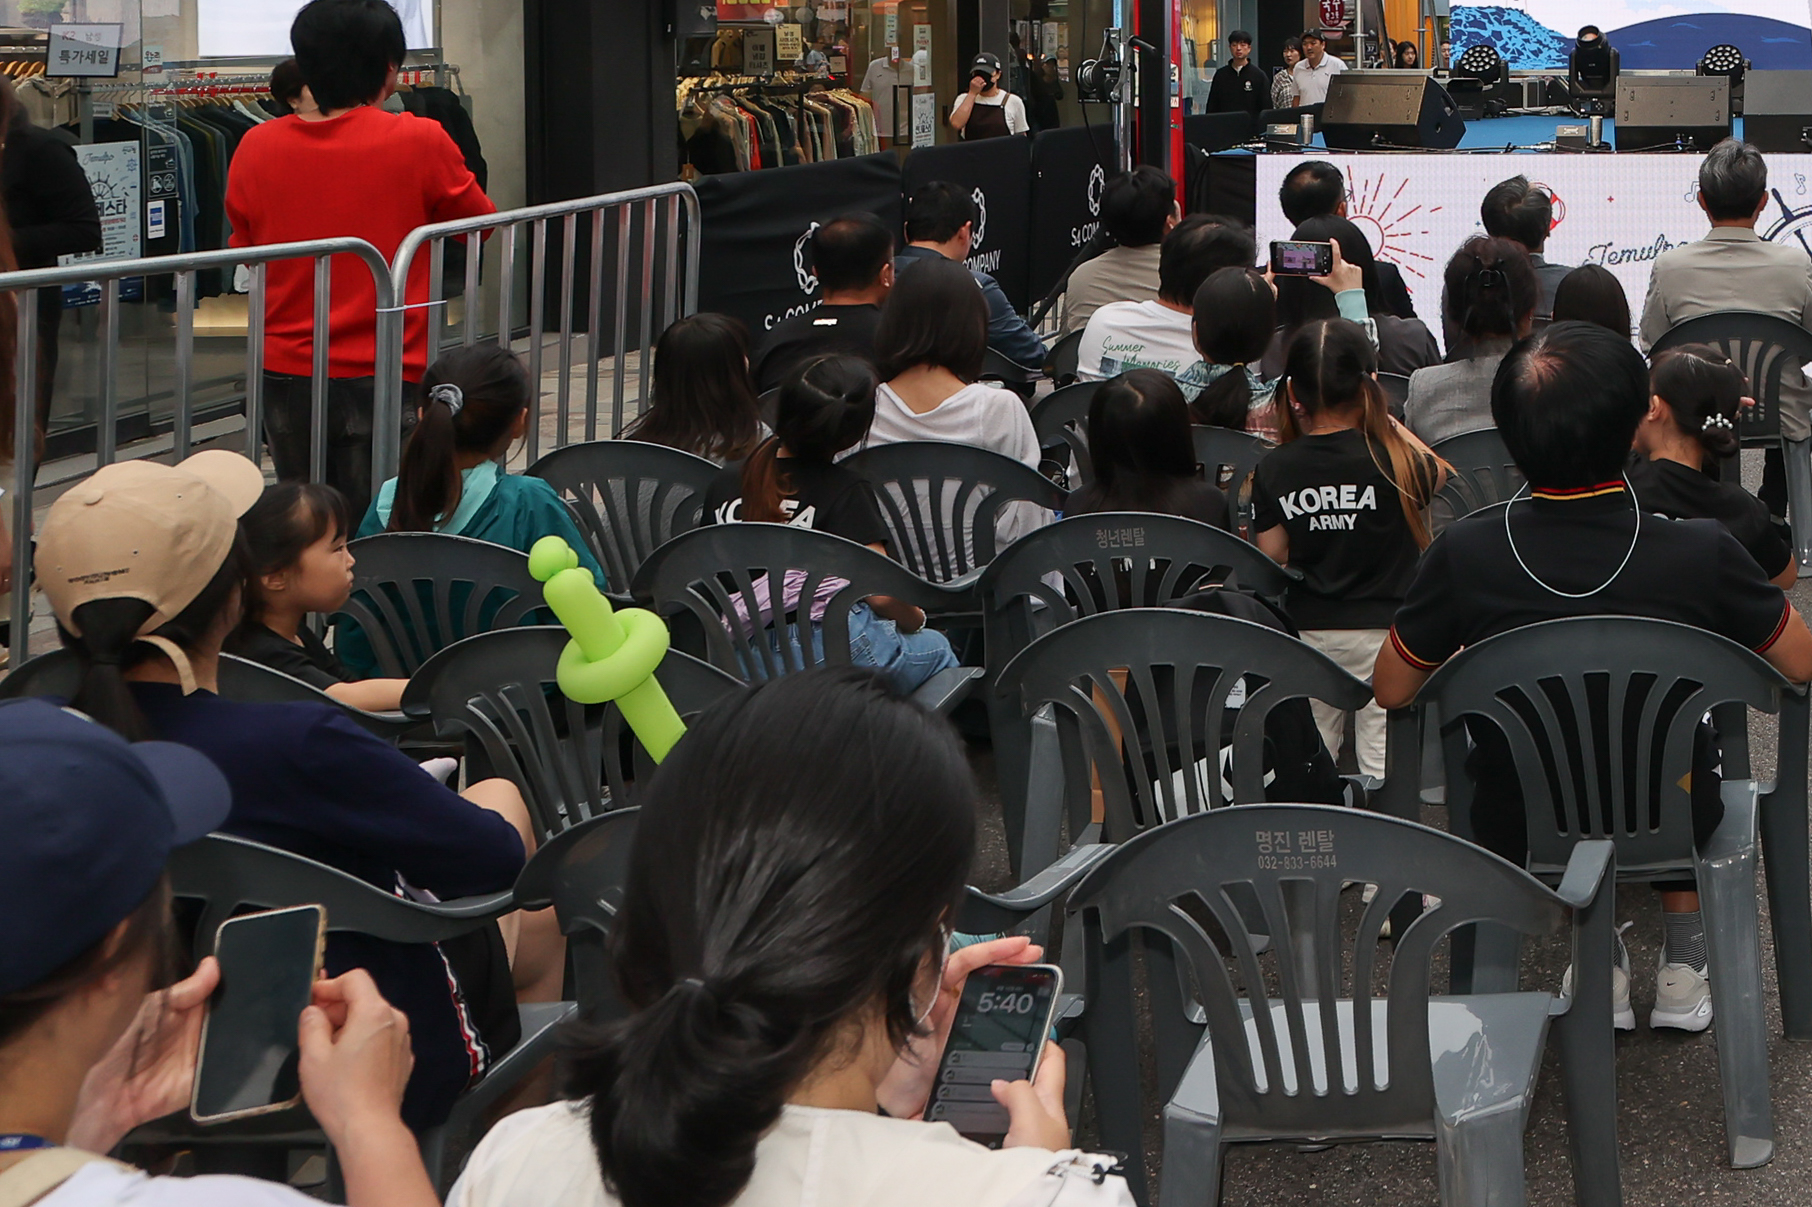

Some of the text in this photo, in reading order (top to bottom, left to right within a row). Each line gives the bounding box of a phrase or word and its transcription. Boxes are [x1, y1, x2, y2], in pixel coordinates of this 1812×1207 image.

[58, 49, 110, 65] 특가세일
[1102, 335, 1147, 356] Summer
[1278, 484, 1377, 521] KOREA
[1309, 513, 1359, 532] ARMY
[1095, 527, 1145, 549] 청년렌탈
[1255, 829, 1335, 853] 명진 렌탈
[1257, 854, 1337, 870] 032-833-6644
[976, 992, 1034, 1015] 5:40
